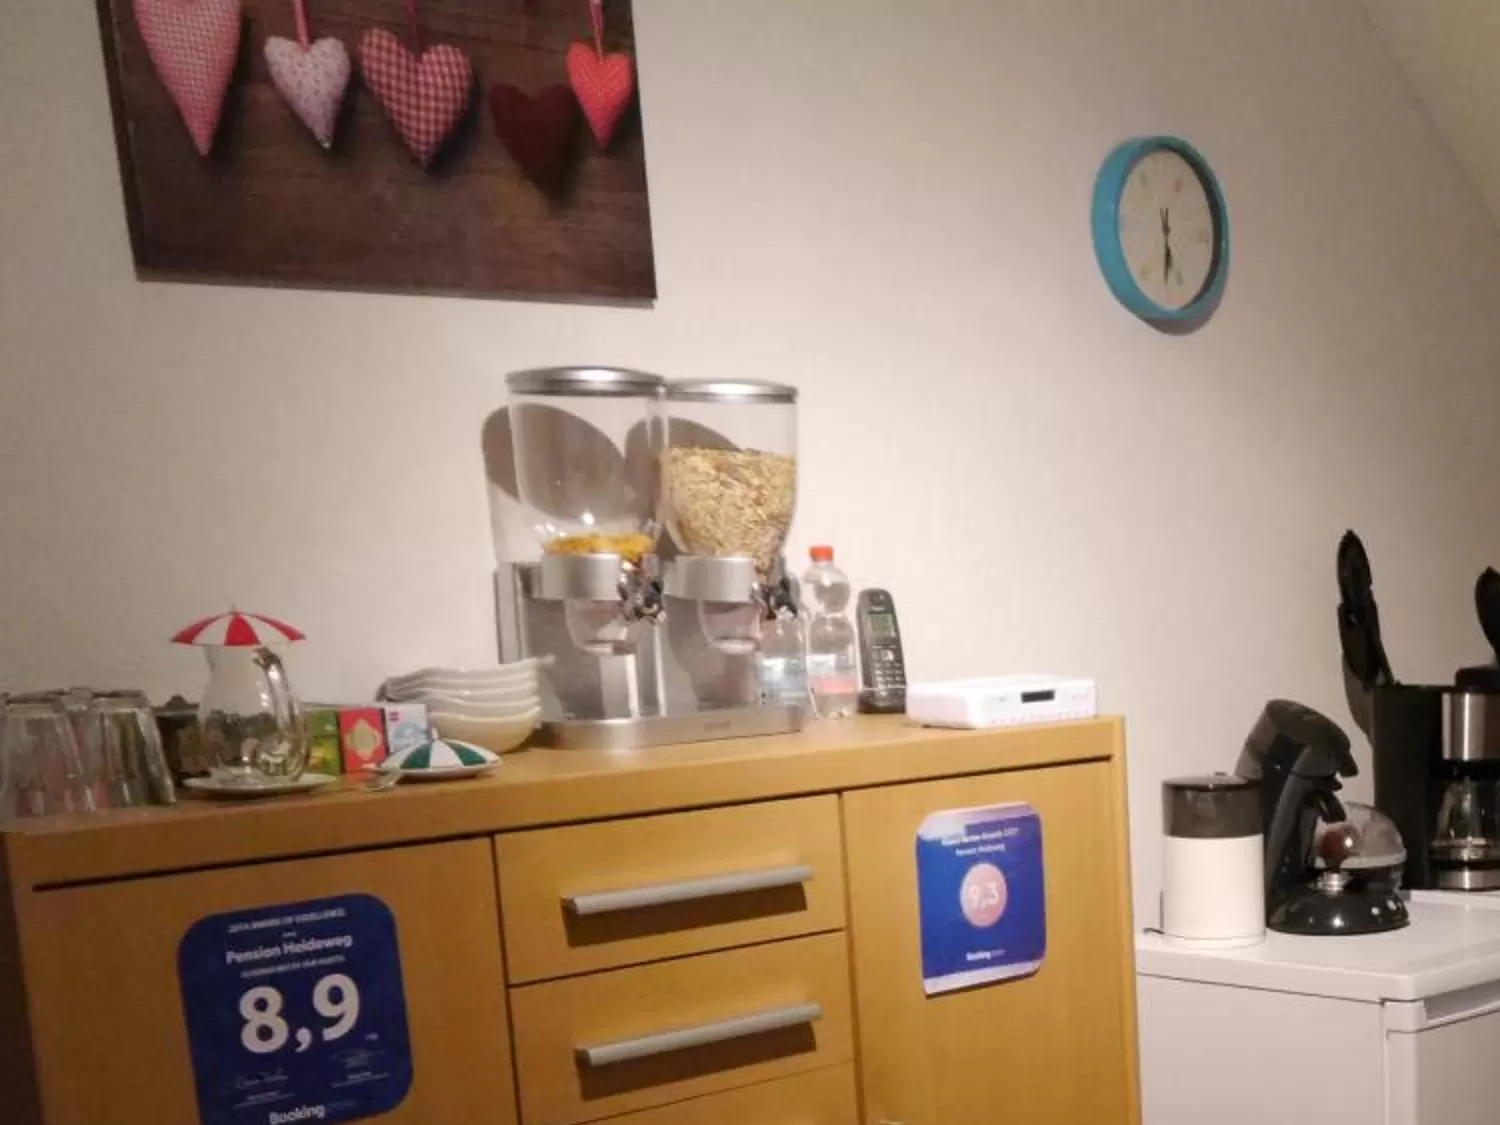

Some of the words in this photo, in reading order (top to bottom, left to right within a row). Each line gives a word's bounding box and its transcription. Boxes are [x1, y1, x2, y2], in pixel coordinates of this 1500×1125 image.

[225, 945, 281, 965] Pension
[239, 972, 360, 1053] 8,9
[269, 1104, 326, 1125] Booking
